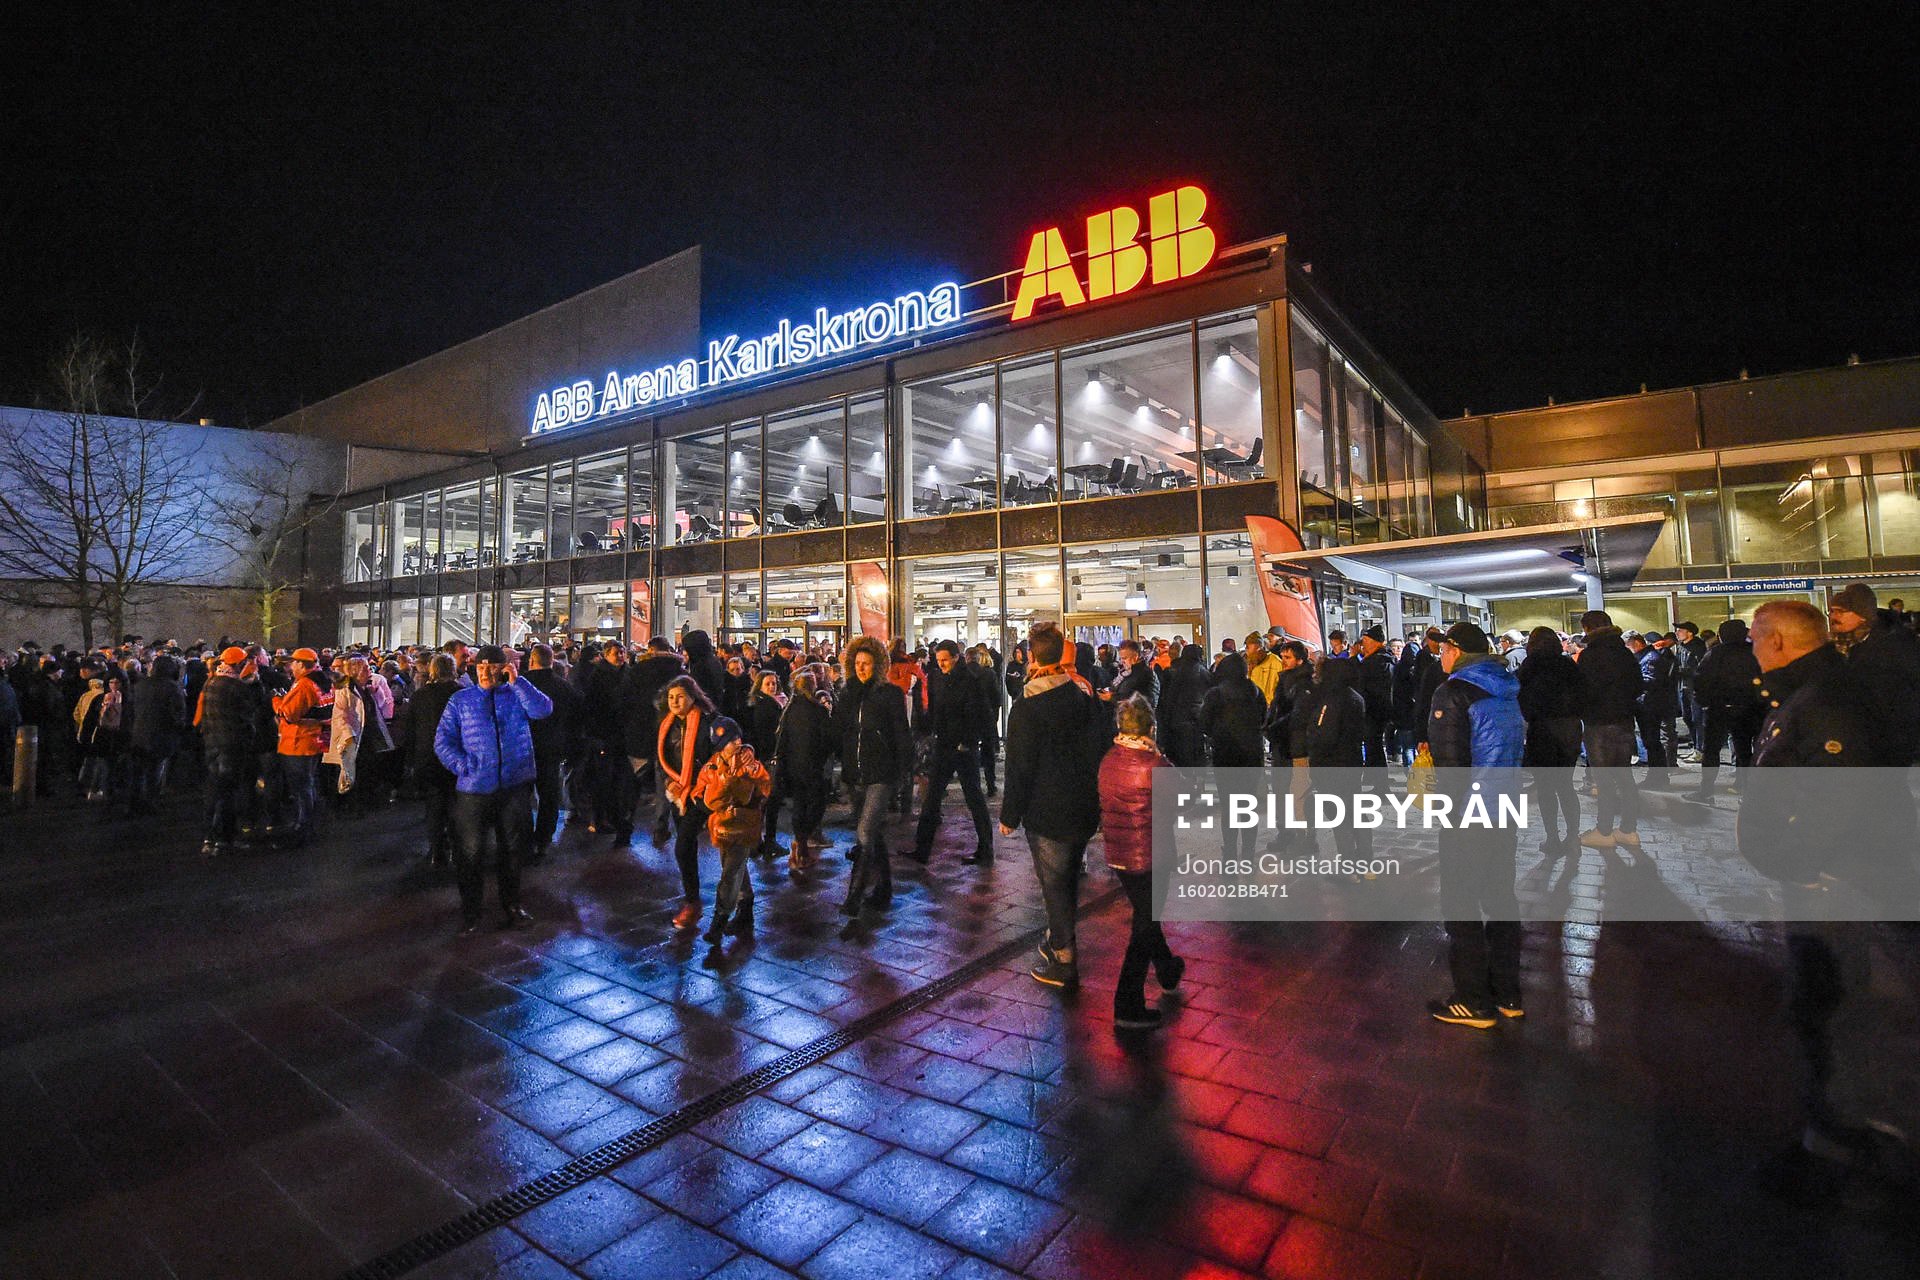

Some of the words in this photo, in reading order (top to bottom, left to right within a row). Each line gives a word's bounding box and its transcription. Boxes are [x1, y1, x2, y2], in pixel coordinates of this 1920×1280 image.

[1010, 185, 1216, 322] ABB
[531, 380, 594, 434] ABB
[599, 358, 700, 416] Arena
[707, 282, 961, 386] Karlskrona
[1692, 583, 1743, 593] Badminton-
[1745, 583, 1762, 591] och
[1763, 580, 1807, 590] tennishall
